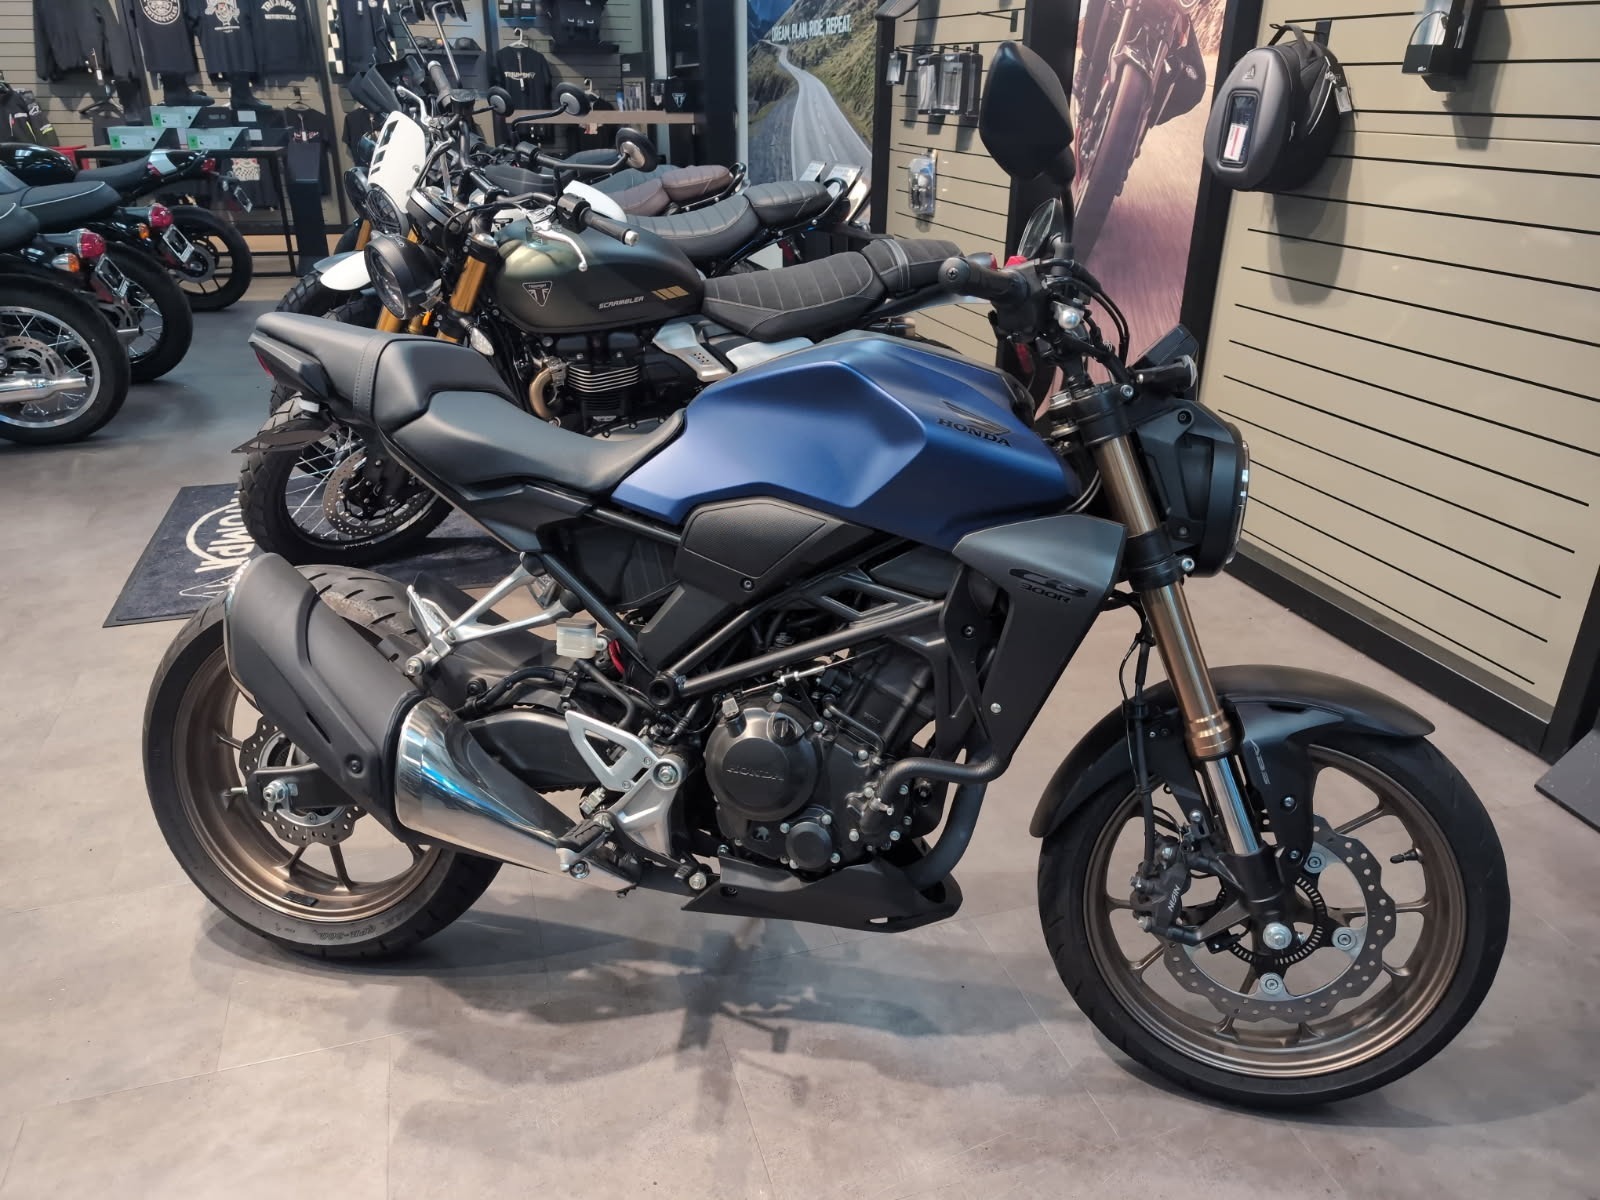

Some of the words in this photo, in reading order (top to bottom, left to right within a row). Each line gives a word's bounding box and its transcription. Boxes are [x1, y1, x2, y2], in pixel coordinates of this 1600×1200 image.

[771, 23, 791, 42] DREAM,
[791, 20, 808, 39] PLAN,
[599, 295, 644, 310] SCRAMBLER
[937, 417, 1012, 448] HONDA
[1020, 582, 1071, 604] 300R
[725, 766, 785, 781] HONDA
